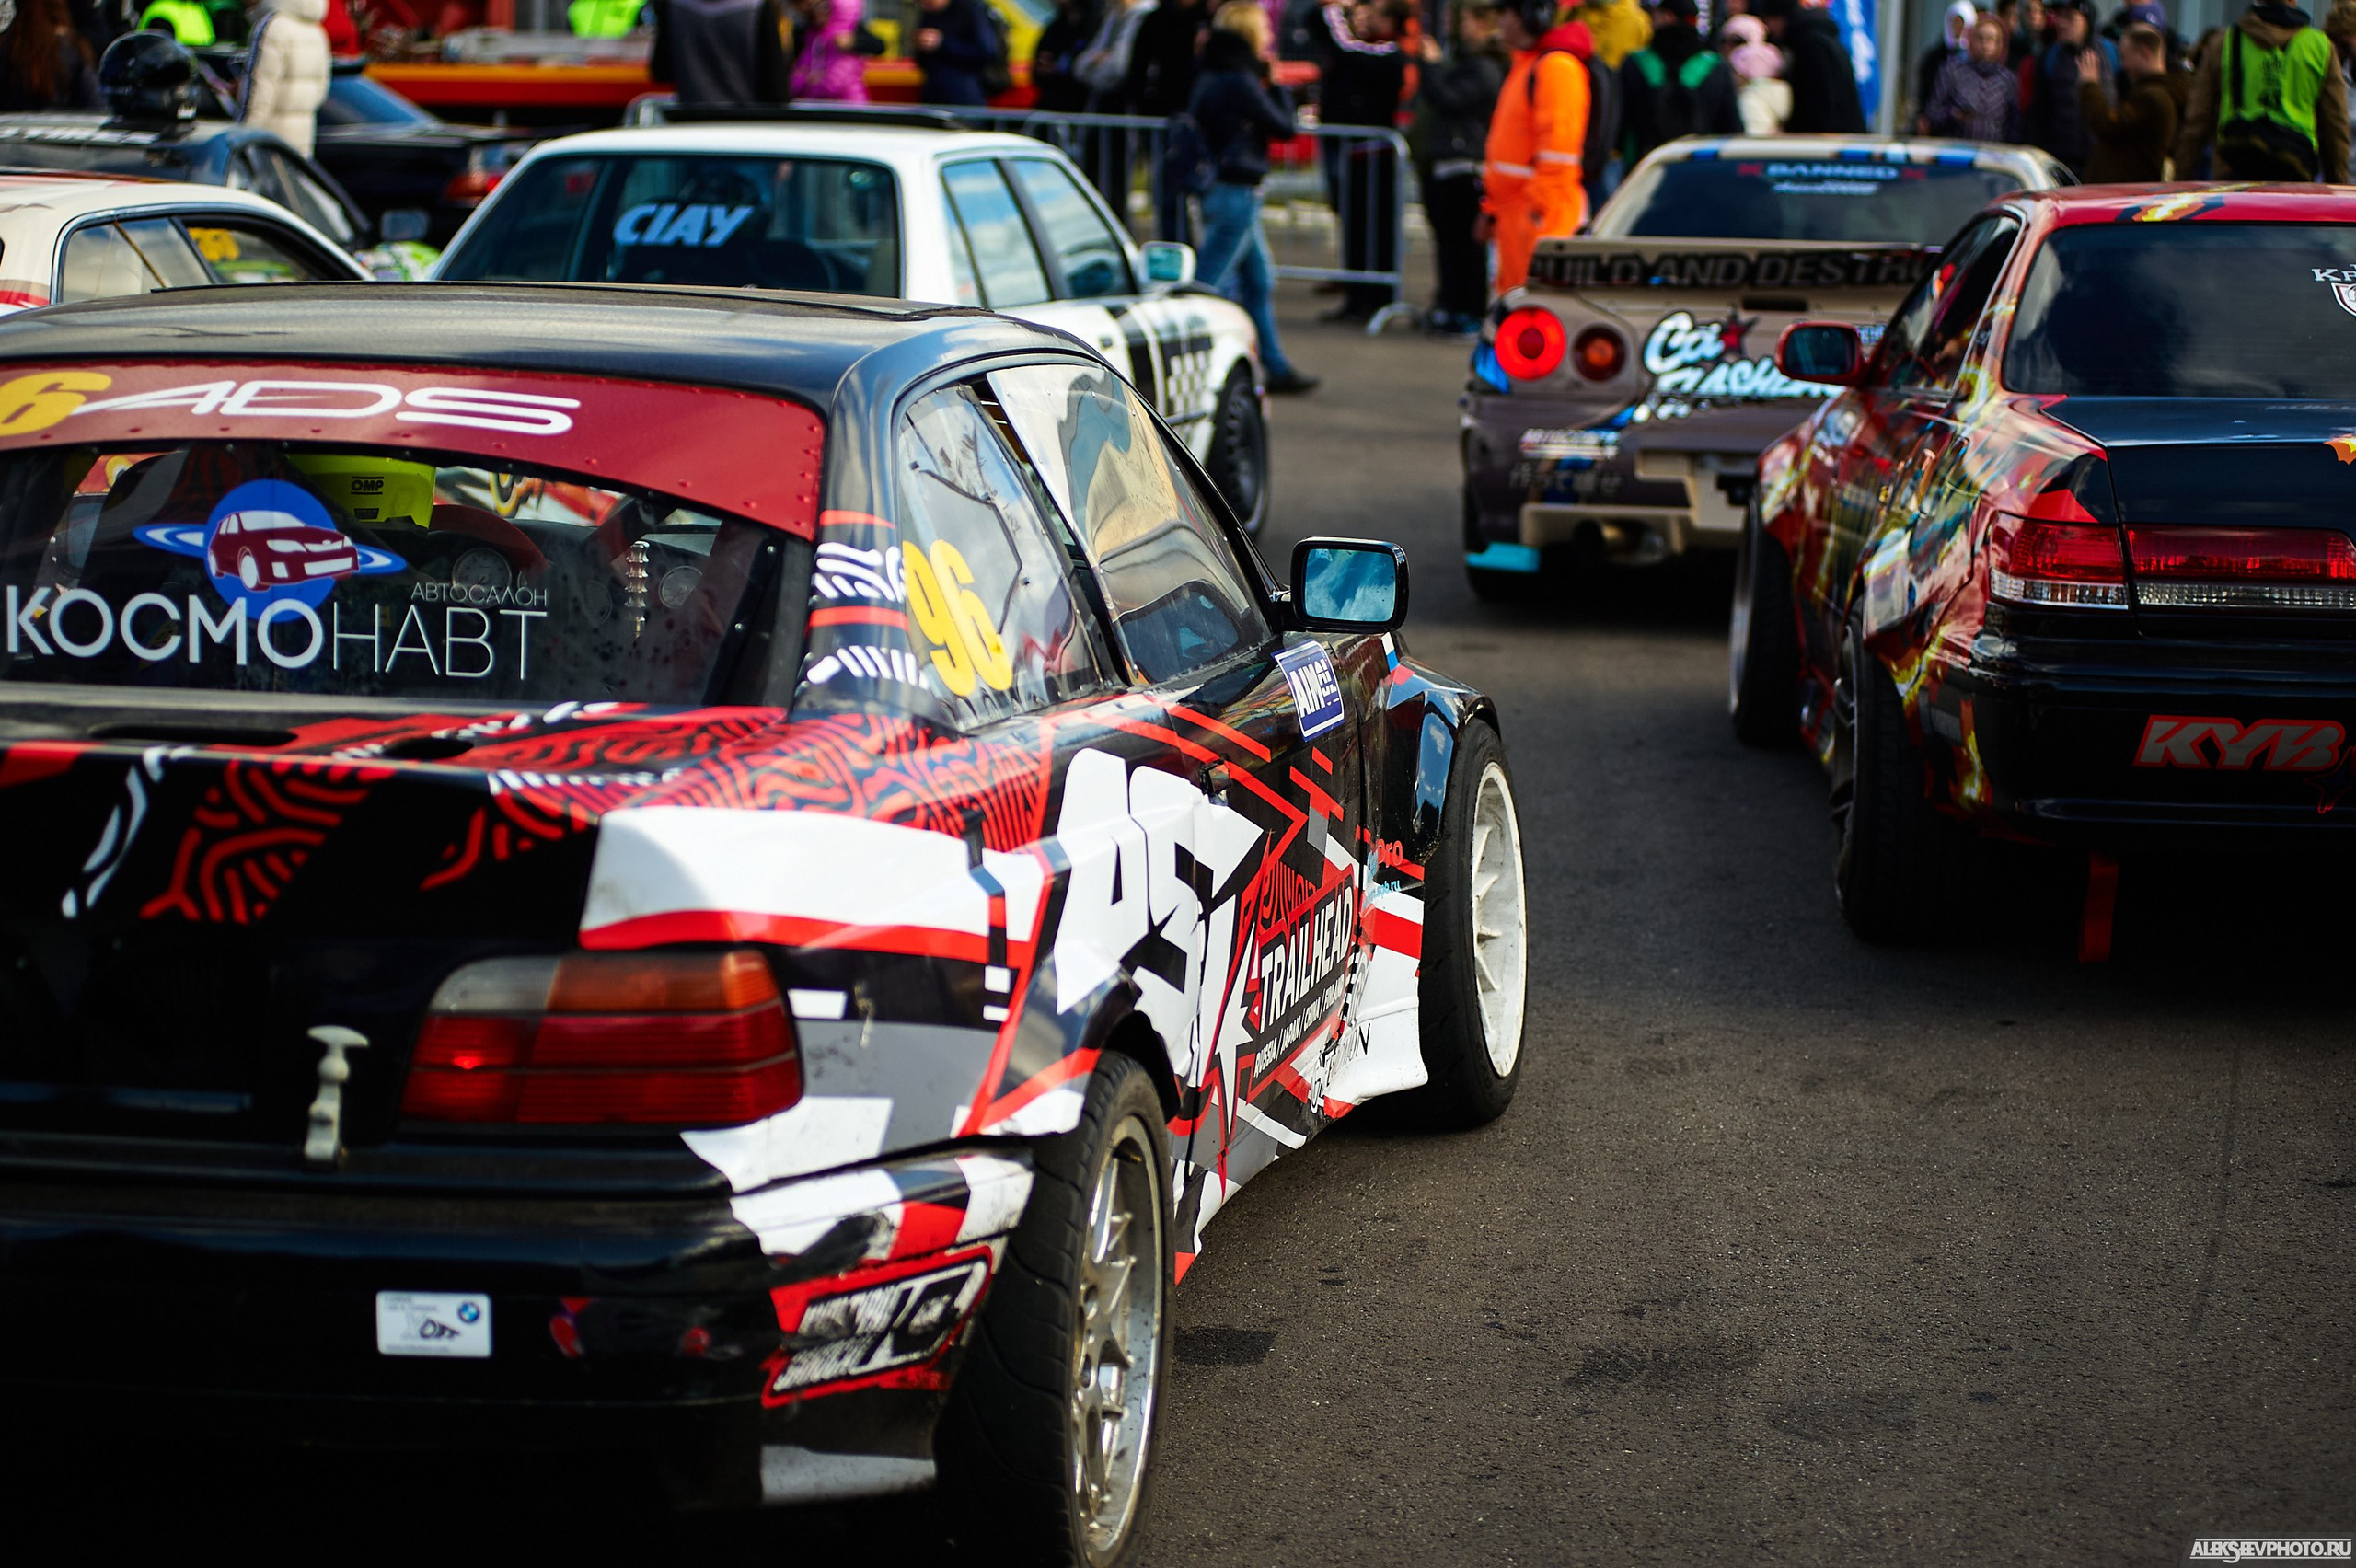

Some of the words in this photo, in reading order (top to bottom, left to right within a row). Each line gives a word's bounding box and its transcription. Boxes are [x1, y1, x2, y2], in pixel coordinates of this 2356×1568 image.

[1654, 254, 1749, 287] AND
[351, 479, 384, 492] OMP
[411, 581, 548, 607] АВТОСАЛОН
[902, 538, 1014, 698] 96
[6, 584, 549, 681] КОСМОНАВТ
[2135, 717, 2343, 770] KYB
[1259, 885, 1354, 1035] TRAILHEAD
[1253, 1036, 1277, 1078] RUSSIA
[1279, 1015, 1302, 1055] JAPAN
